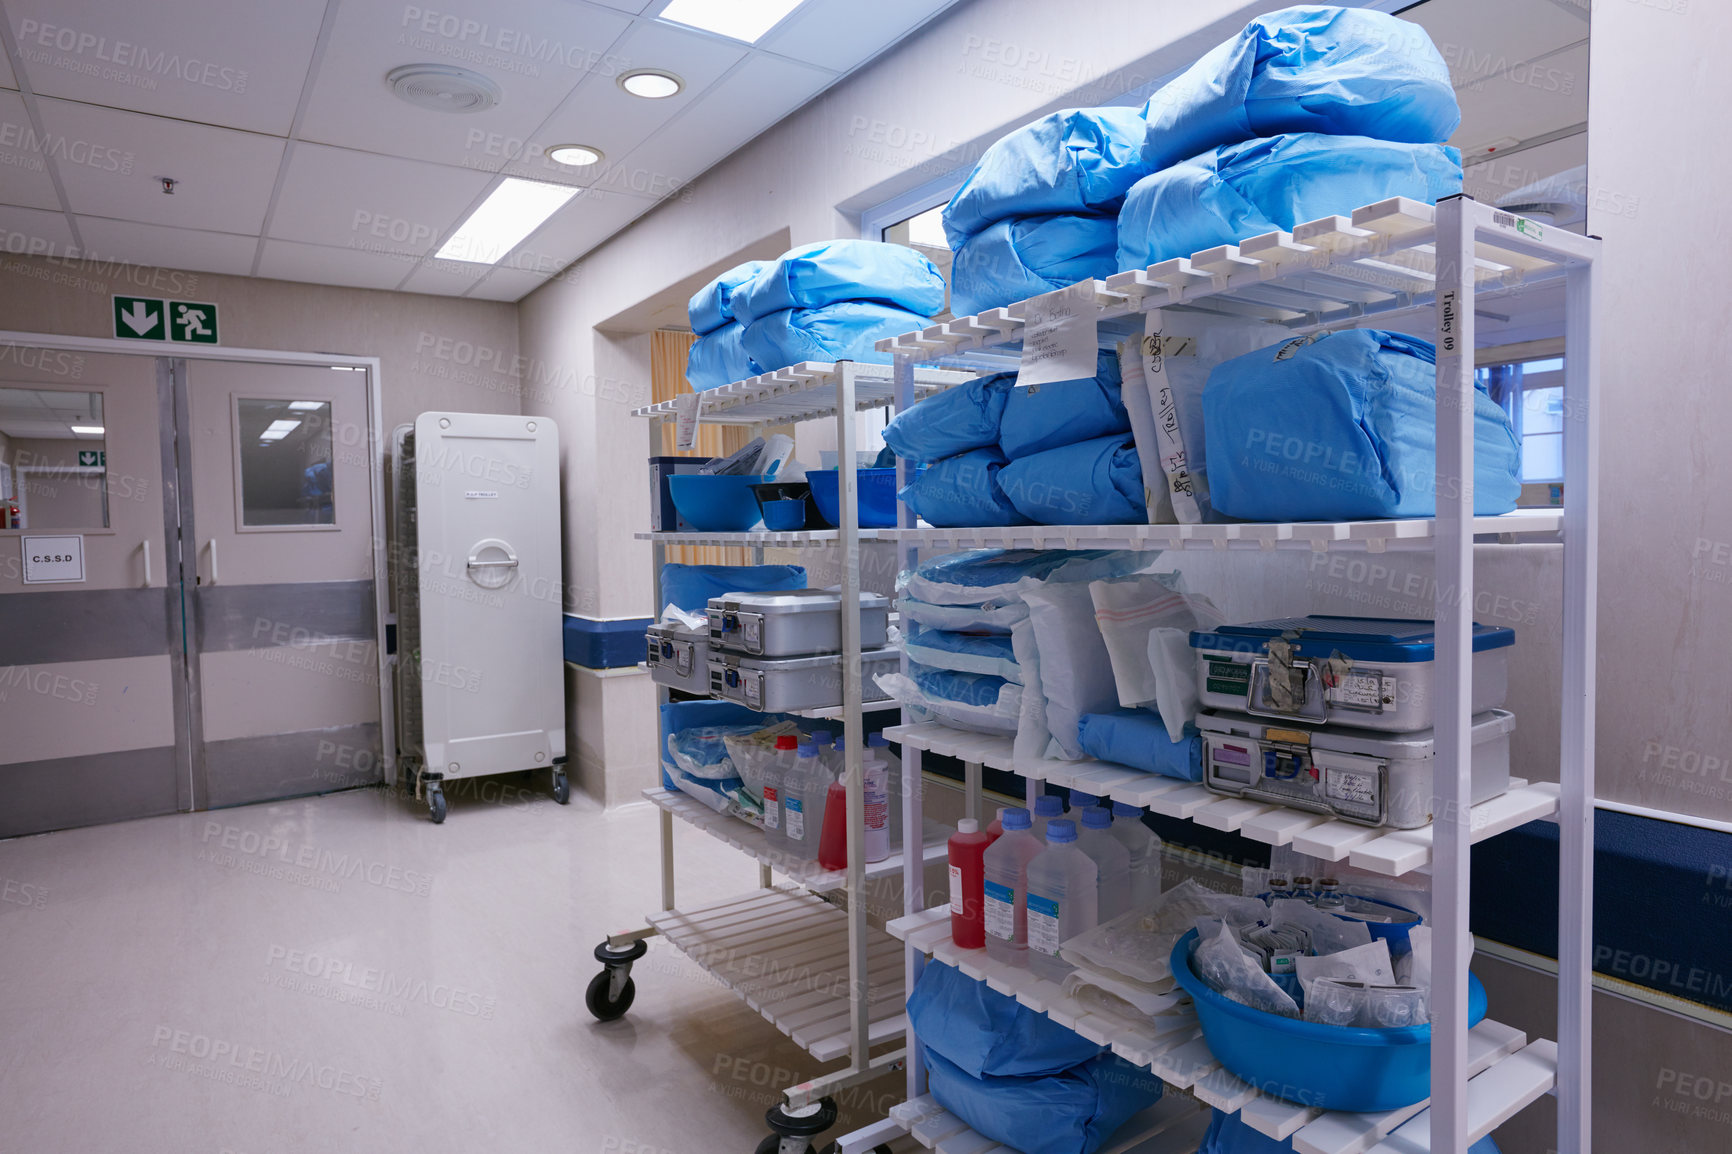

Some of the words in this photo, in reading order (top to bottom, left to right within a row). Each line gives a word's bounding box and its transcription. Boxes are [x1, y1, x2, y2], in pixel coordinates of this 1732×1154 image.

[1442, 290, 1455, 334] Trolley
[1443, 337, 1455, 351] 09
[33, 555, 72, 563] C.S.S.D
